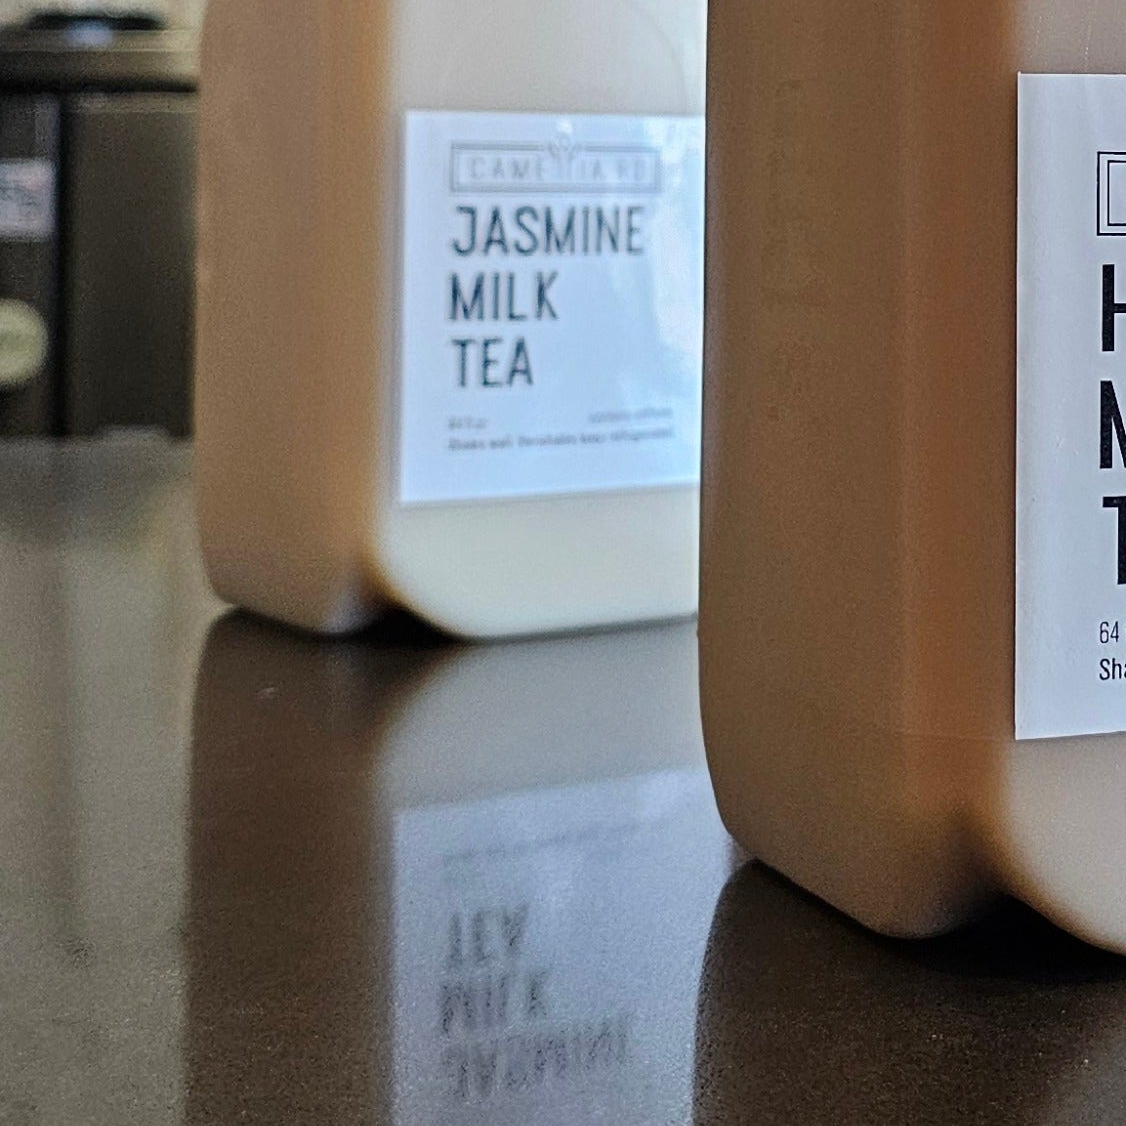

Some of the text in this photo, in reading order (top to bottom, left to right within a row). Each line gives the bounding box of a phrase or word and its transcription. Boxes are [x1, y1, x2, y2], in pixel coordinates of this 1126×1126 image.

[452, 204, 646, 258] JASMINE
[449, 270, 559, 322] MILK
[451, 336, 534, 388] TEA
[1099, 621, 1120, 644] 64
